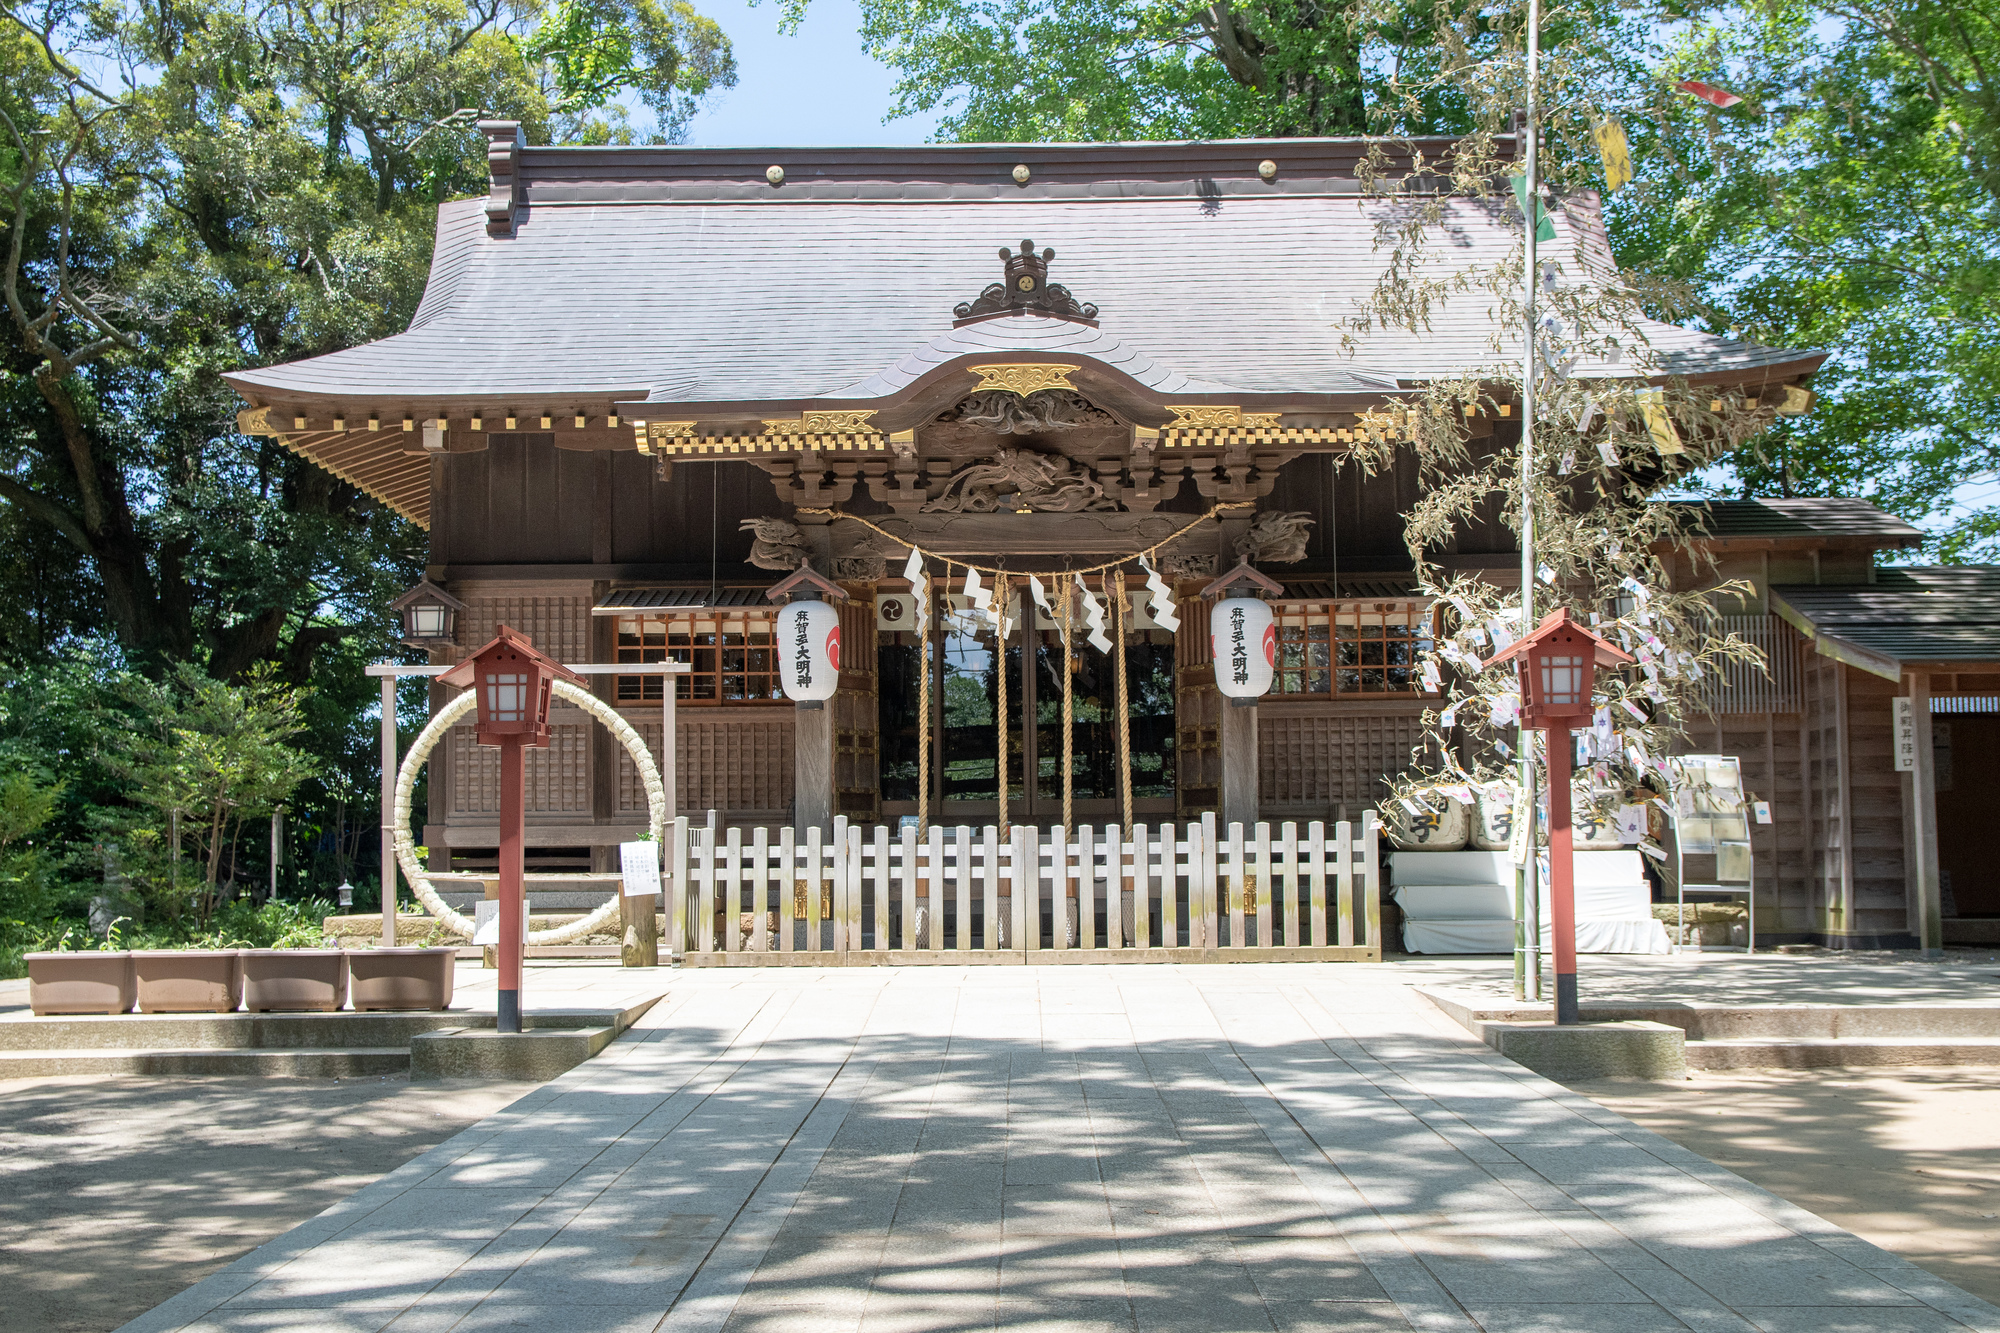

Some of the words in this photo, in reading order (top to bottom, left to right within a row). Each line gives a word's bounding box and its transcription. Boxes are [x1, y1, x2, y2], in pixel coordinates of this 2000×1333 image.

[794, 610, 812, 688] 麻賀多大明神
[1230, 607, 1248, 685] 麻賀多大明神
